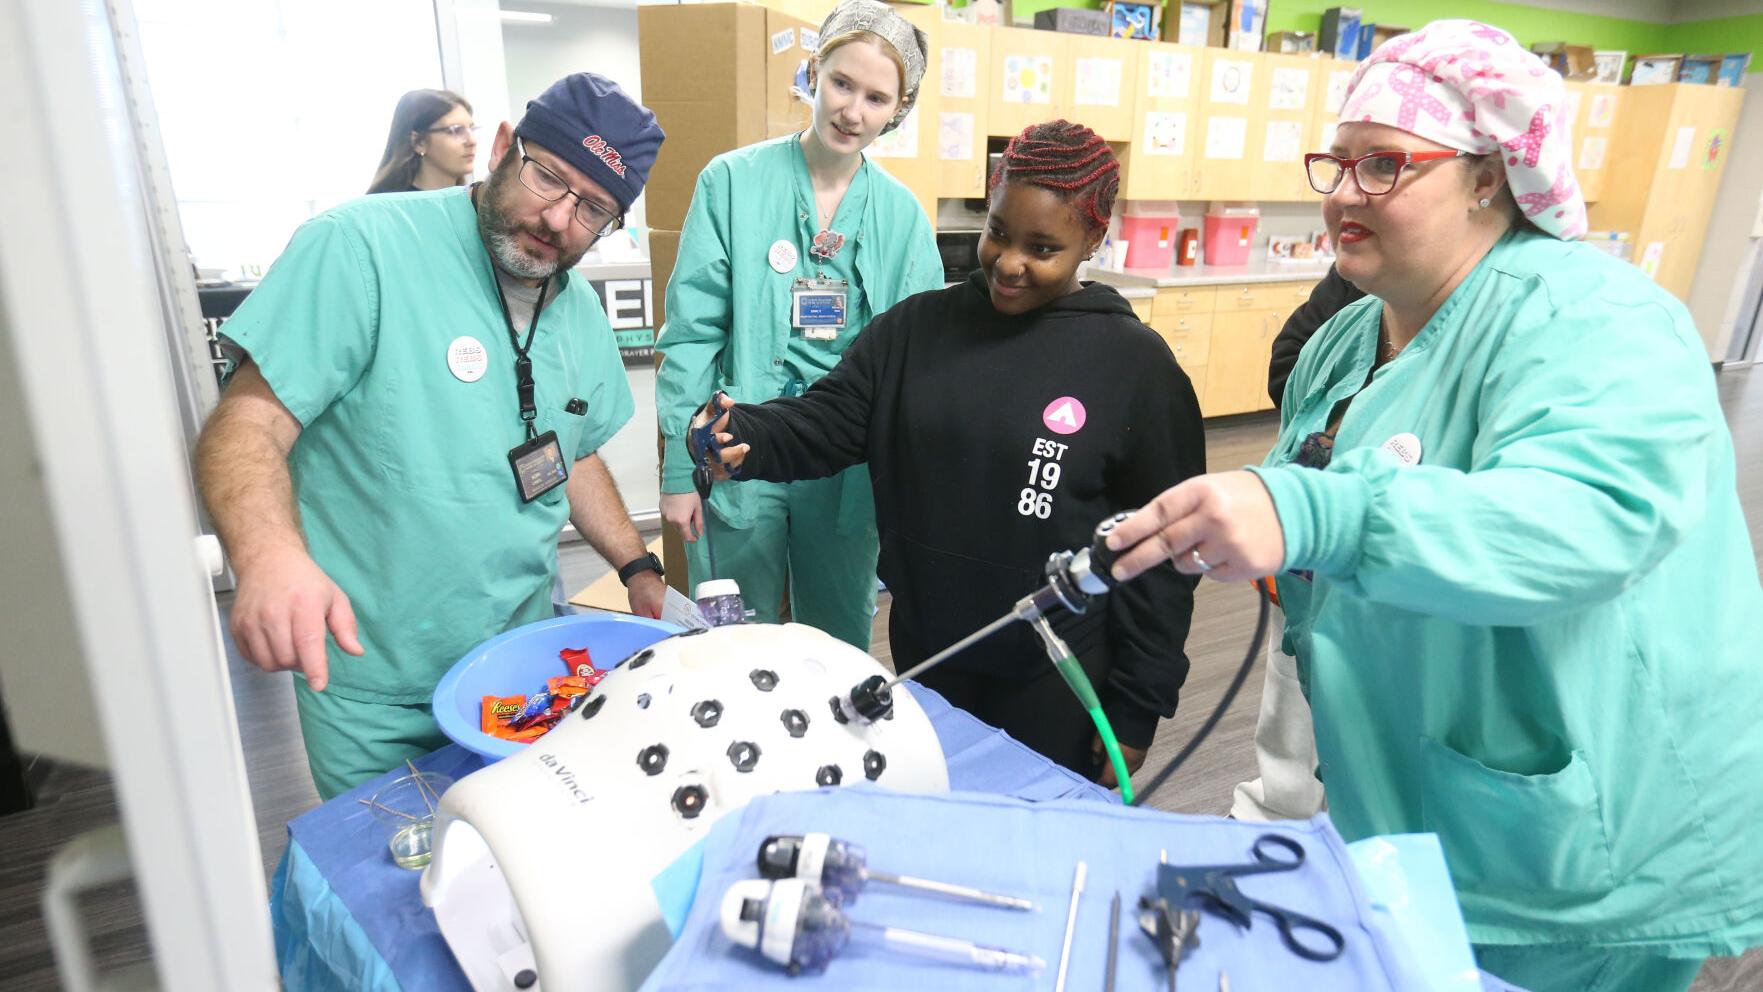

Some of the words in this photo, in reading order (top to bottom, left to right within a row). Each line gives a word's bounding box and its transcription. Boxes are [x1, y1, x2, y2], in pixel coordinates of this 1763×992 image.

[582, 135, 607, 156] Ole
[600, 147, 627, 175] Miss
[1032, 437, 1068, 461] EST
[1027, 458, 1061, 490] 19
[1017, 487, 1053, 519] 86
